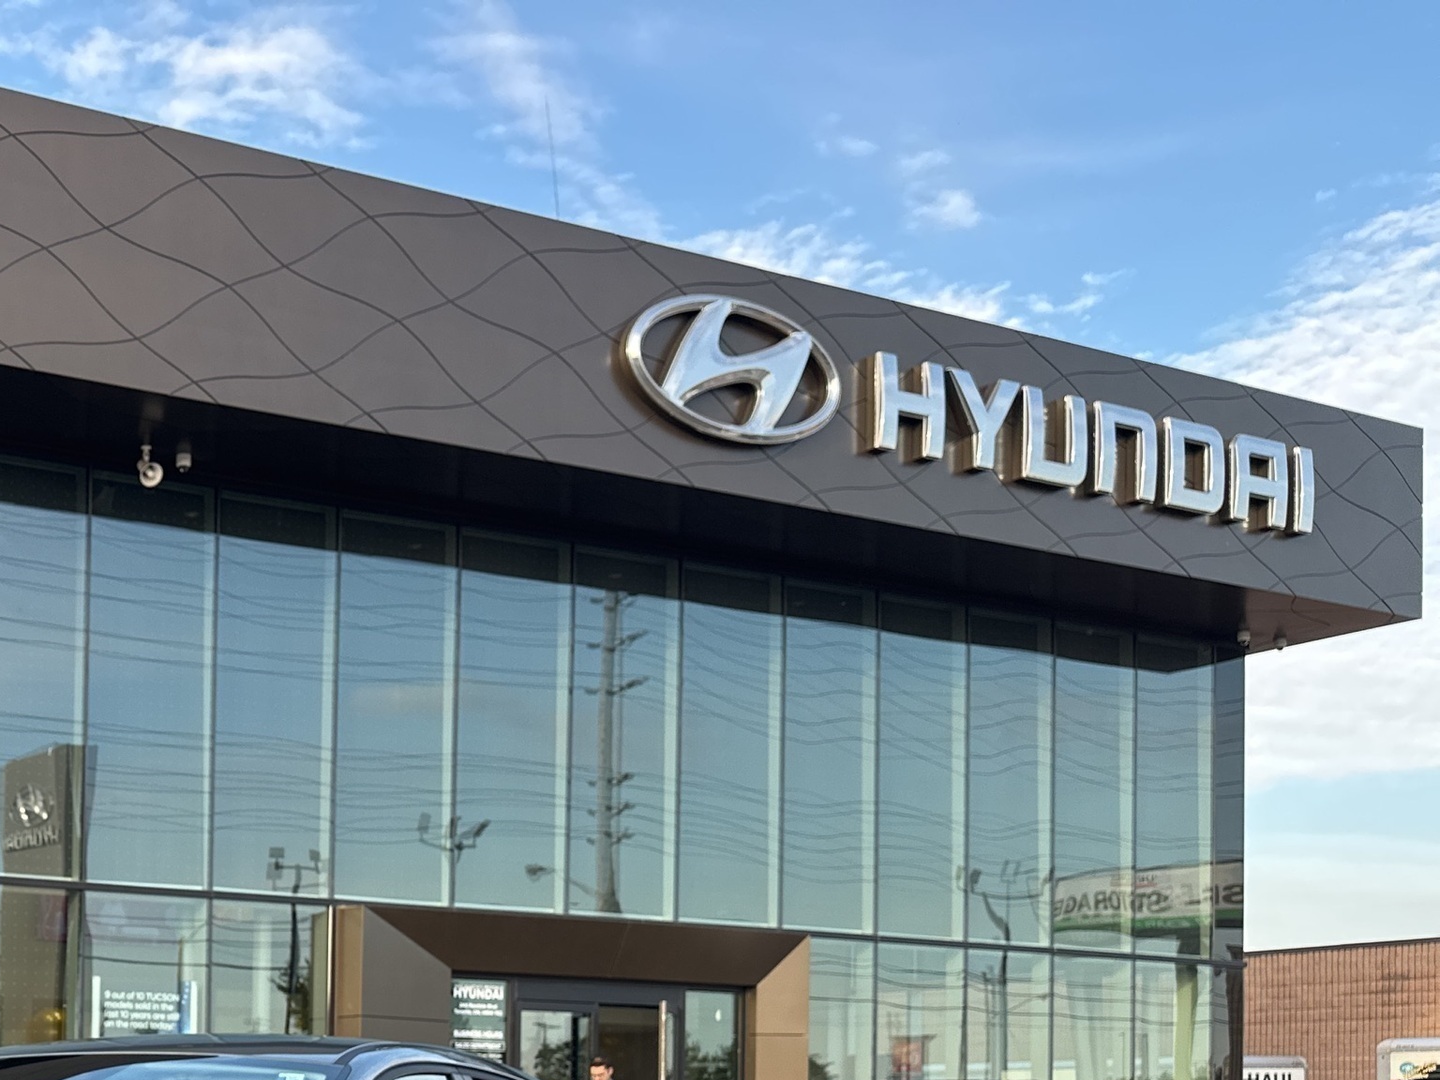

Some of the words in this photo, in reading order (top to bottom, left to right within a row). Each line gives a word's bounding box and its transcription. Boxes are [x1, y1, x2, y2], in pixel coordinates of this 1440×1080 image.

[871, 350, 1316, 536] HYUNDAI
[111, 991, 125, 1000] out
[126, 991, 135, 1000] of
[136, 991, 145, 1001] 10
[146, 992, 180, 1002] TUCSON
[453, 985, 504, 1000] HYUNDAI
[160, 1002, 174, 1011] the
[115, 1020, 129, 1028] the
